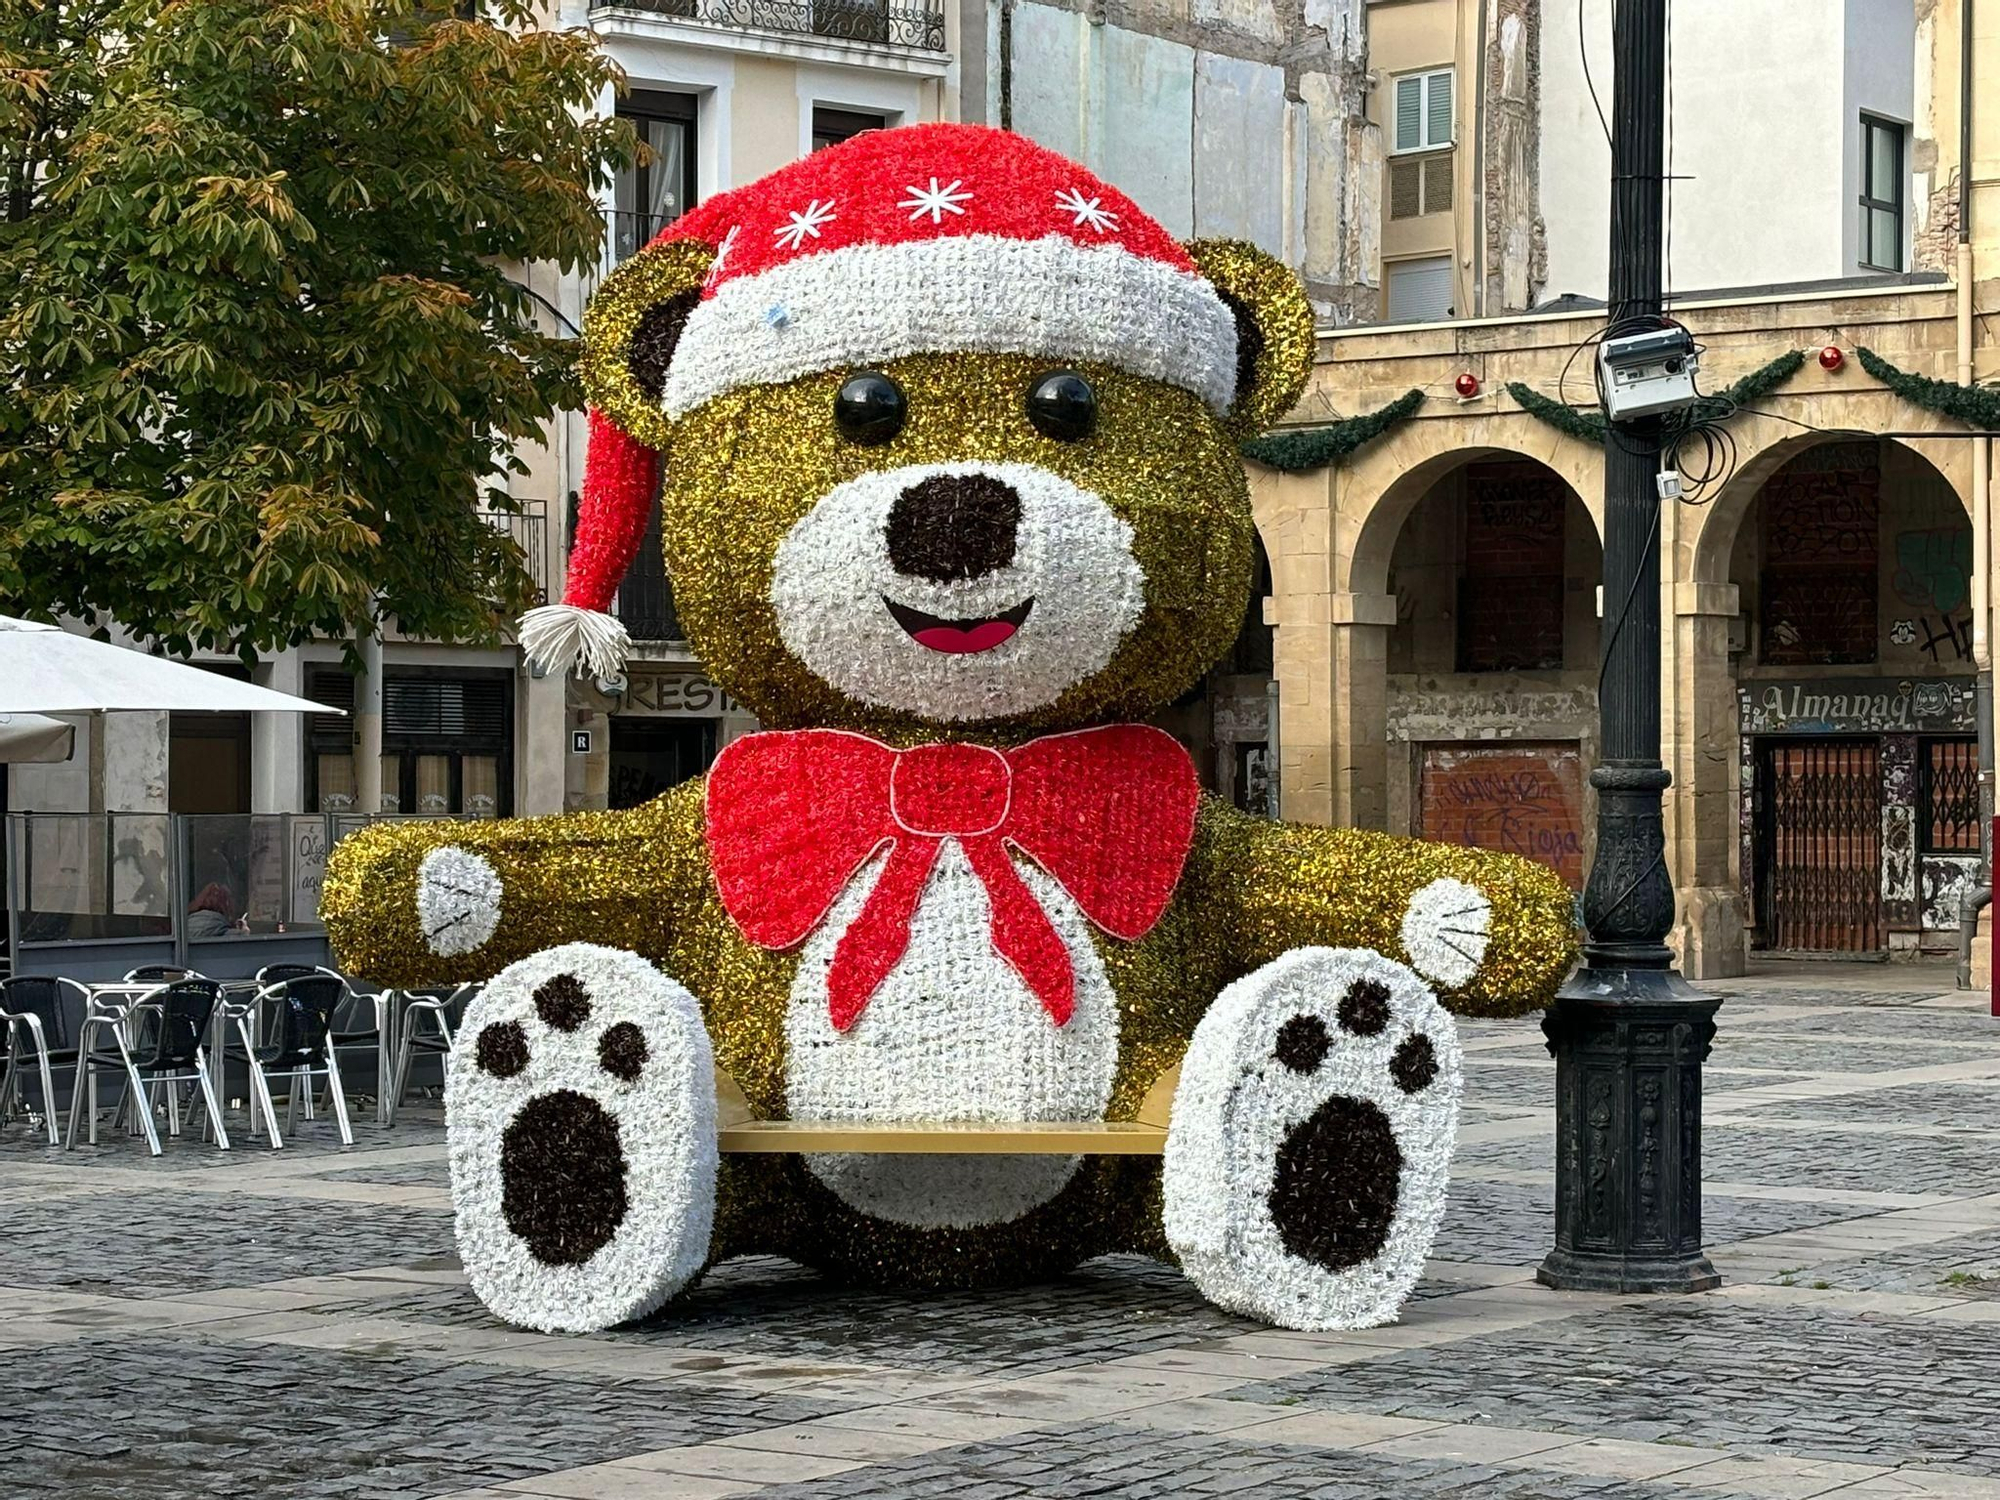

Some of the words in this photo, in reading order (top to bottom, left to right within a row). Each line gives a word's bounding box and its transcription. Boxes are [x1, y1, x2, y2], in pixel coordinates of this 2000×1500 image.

[626, 677, 738, 711] REST
[1761, 685, 1938, 726] Almanaq
[577, 737, 587, 748] R
